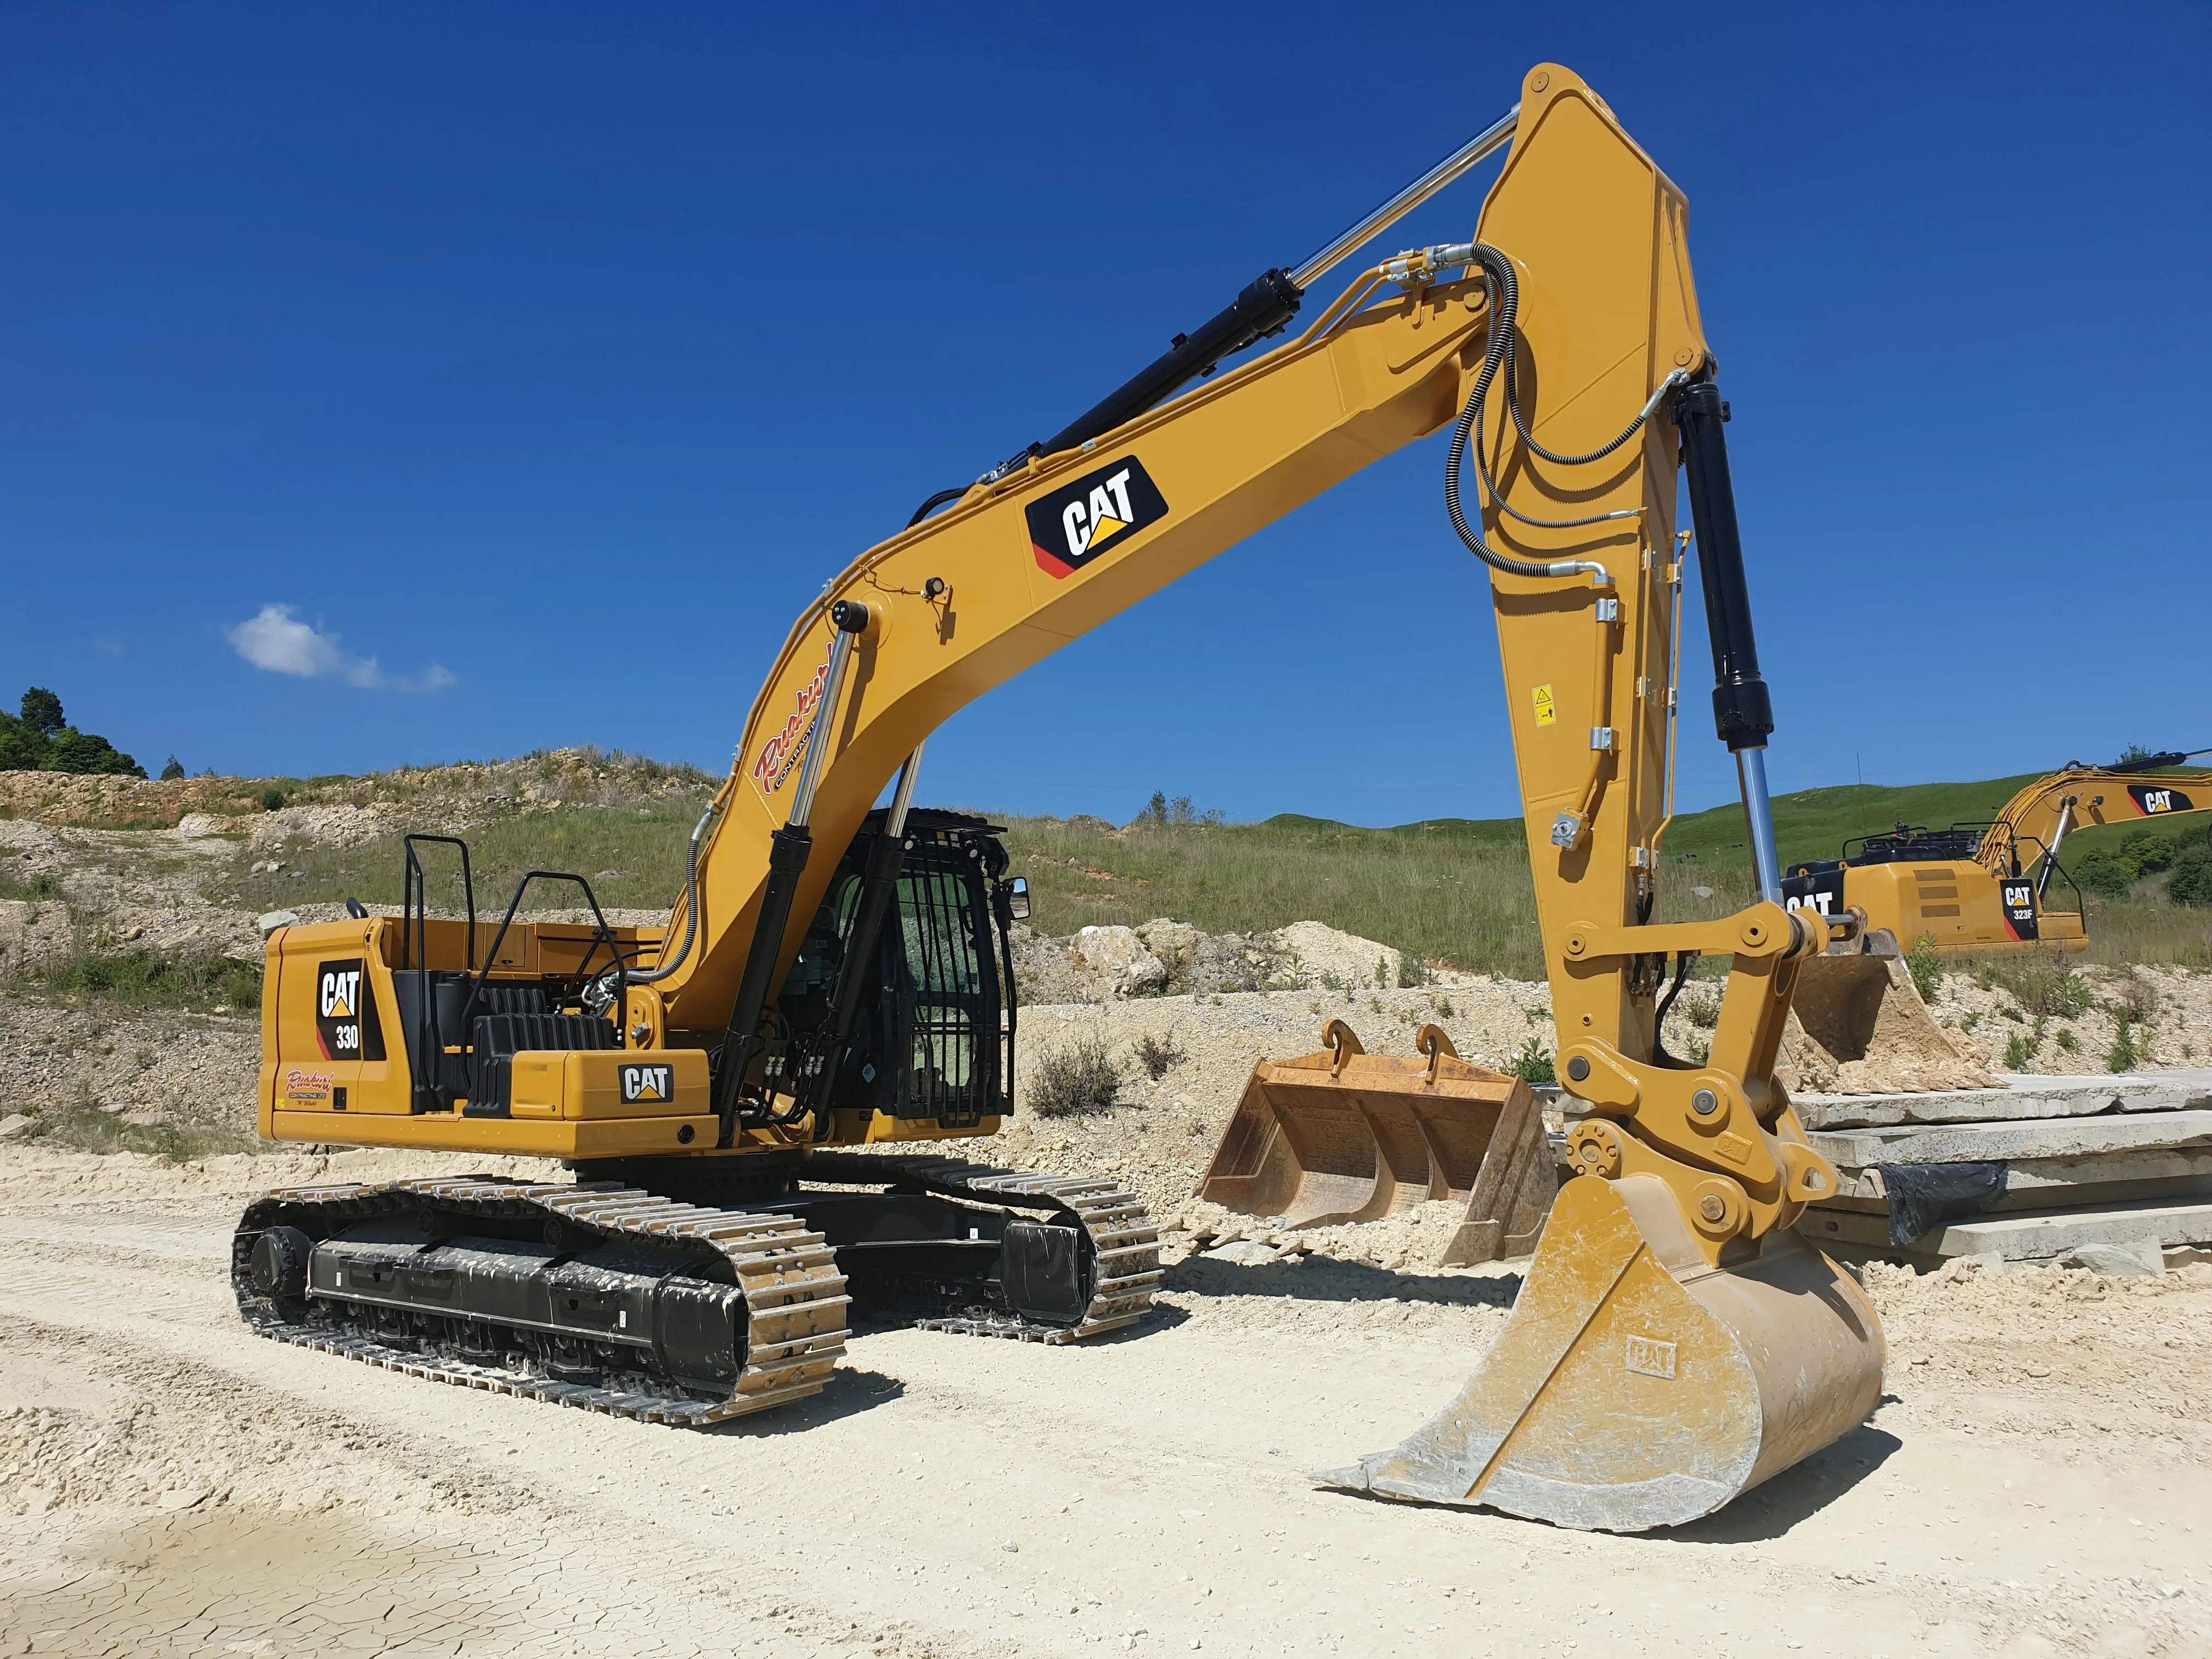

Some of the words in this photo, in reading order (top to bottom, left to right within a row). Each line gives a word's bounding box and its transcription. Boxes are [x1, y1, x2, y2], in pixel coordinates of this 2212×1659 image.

[1063, 468, 1134, 556] CAT
[2145, 791, 2171, 812] CAT
[2005, 887, 2030, 906] CAT
[2013, 910, 2033, 919] 323F
[321, 971, 360, 1017] CAT
[336, 1025, 358, 1049] 330
[625, 1068, 668, 1099] CAT
[1630, 1341, 1671, 1372] CAT
